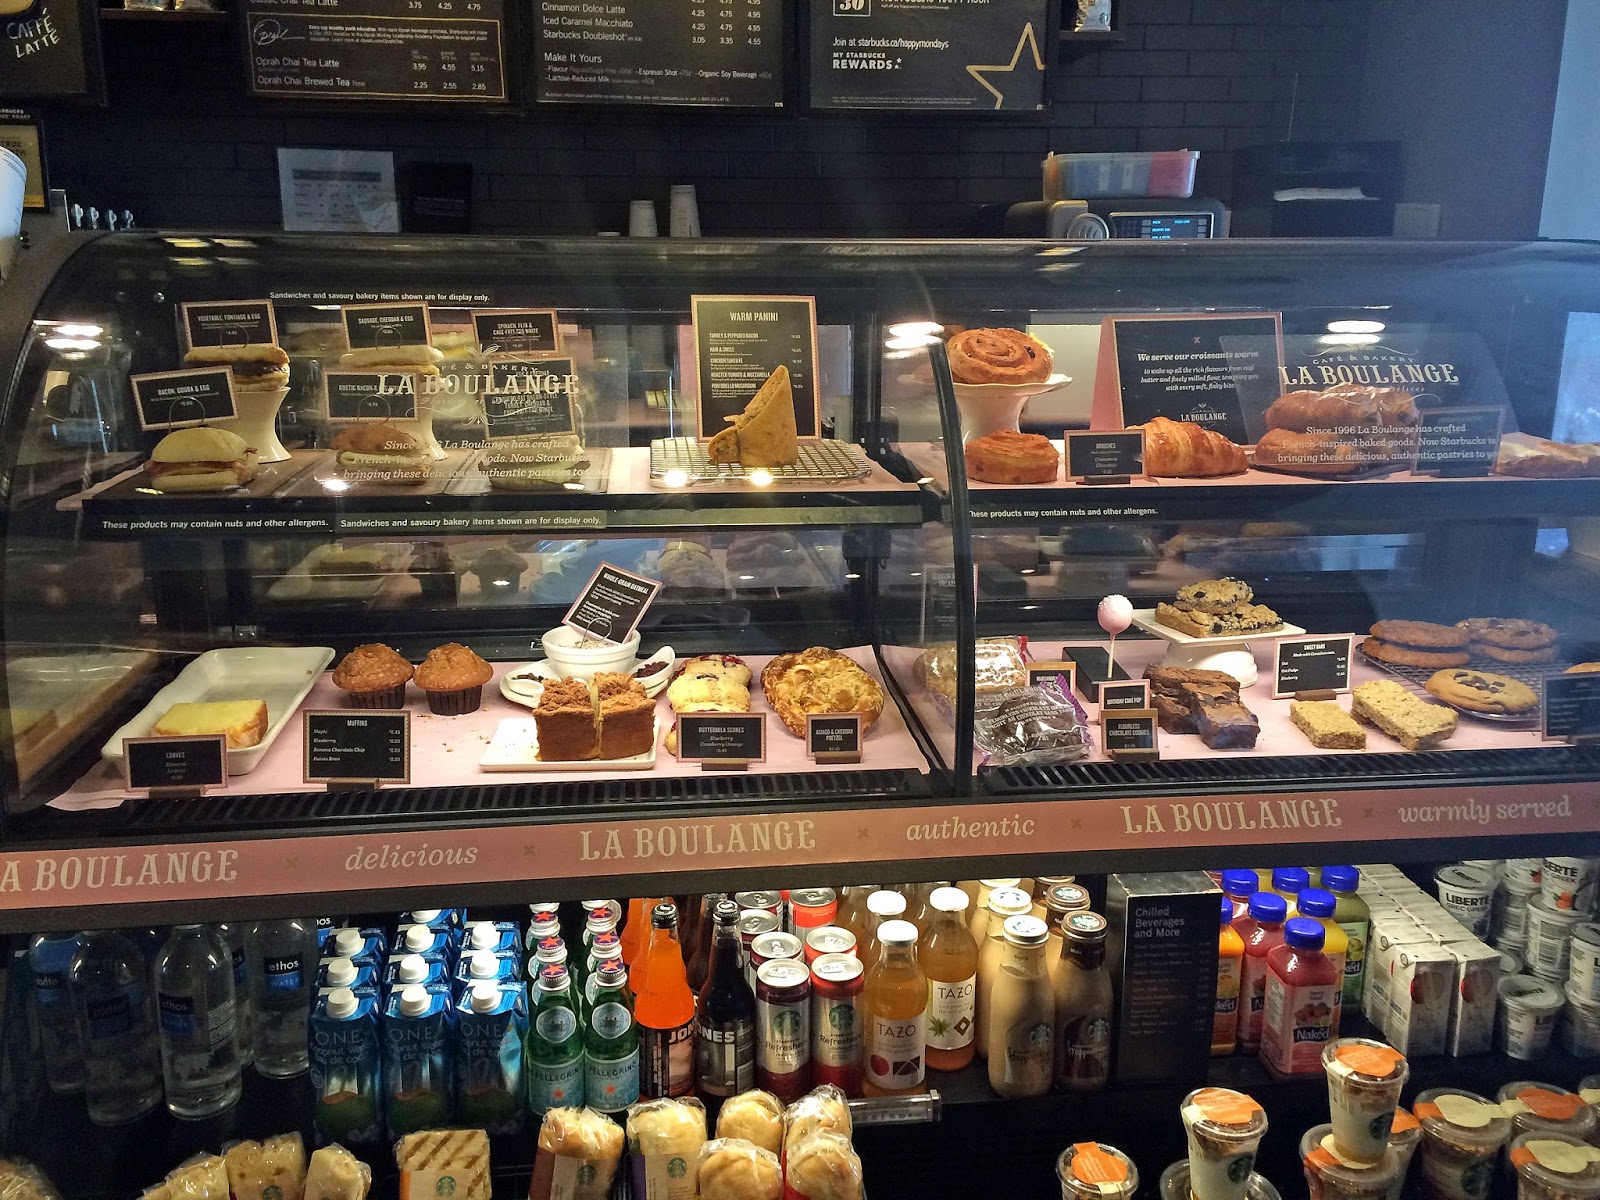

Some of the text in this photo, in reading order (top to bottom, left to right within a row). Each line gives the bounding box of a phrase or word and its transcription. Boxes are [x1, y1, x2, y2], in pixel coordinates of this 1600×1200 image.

[408, 1, 481, 11] 3.75 4.25 4.75
[541, 2, 733, 18] Cinnamon Dolce Latte 4.25 4.75
[6, 7, 55, 40] CAFFÉ
[543, 16, 761, 32] Iced Caramel Macchiato 4.25 4.75 4.95
[543, 29, 581, 40] Starbucks
[720, 37, 734, 45] 3.35
[833, 37, 949, 50] Join at starbucks.ca/happymondays
[15, 29, 60, 59] LATTE
[256, 56, 427, 71] Oprah Chai Tea Latte 3.95
[544, 52, 603, 63] Make It Yours
[833, 59, 893, 70] REWARDS
[598, 75, 611, 83] Milk
[721, 70, 732, 79] Soy
[733, 71, 758, 79] Beverage
[258, 74, 428, 89] Oprah Chai Brewed Tea 2.25
[270, 292, 311, 300] Sandwiches
[313, 292, 326, 300] and
[355, 292, 379, 302] bakery
[449, 293, 473, 302] display
[474, 294, 490, 302] only.
[730, 312, 779, 322] WARM PANINI
[1137, 353, 1150, 361] We
[1277, 363, 1459, 386] LA BOULANGE
[377, 373, 580, 395] LA BOULANGE
[1181, 412, 1227, 422] LA BOULANGE
[1306, 423, 1467, 436] Since 1996 La Boulange has crafted
[384, 437, 569, 451] Since La Boulange has crafted
[1359, 436, 1487, 449] baked goods. Now Starbucks
[510, 453, 534, 463] Now
[1277, 450, 1485, 464] bringing these delicious, authentic pastries to
[343, 468, 571, 481] bringing these pastries
[990, 509, 1022, 519] products
[1023, 510, 1040, 519] may
[1041, 508, 1068, 517] contain
[1087, 508, 1101, 516] and
[1103, 507, 1121, 516] other
[1123, 507, 1158, 518] allergens.
[102, 518, 329, 531] These products may contain nuts and other allergens.
[341, 516, 601, 529] Sandwiches and savoury bakery items shown are for display only.
[1119, 795, 1572, 834] LA BOULANGE warmly served
[579, 814, 1035, 862] LA BOULANGE authentic
[32, 843, 479, 892] BOULANGE delicious
[1135, 906, 1169, 917] Chilled
[1135, 917, 1185, 929] Beverages
[1134, 927, 1180, 938] and More
[269, 960, 298, 972] ethos
[938, 984, 973, 999] TAZO
[389, 1026, 437, 1042] O.N.E.
[877, 1022, 916, 1038] TAZO
[1297, 1028, 1329, 1040] Naked
[315, 1029, 364, 1045] O.N.E.
